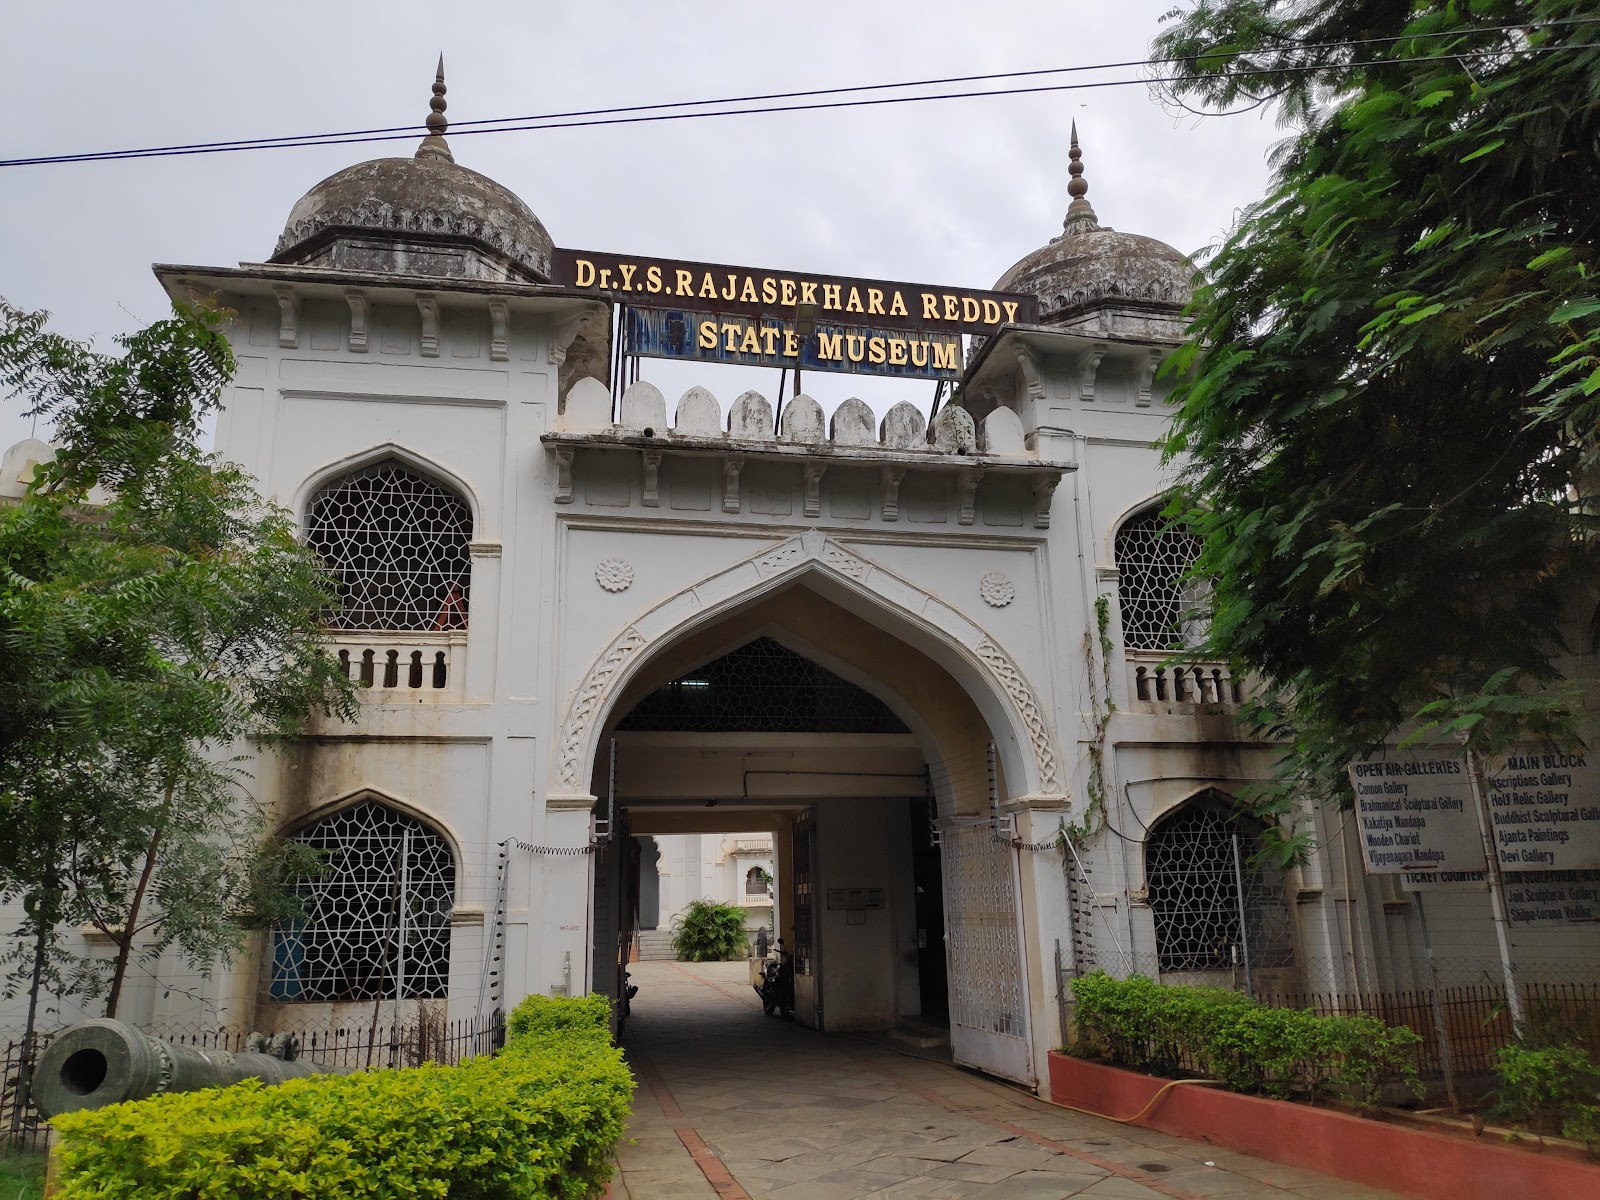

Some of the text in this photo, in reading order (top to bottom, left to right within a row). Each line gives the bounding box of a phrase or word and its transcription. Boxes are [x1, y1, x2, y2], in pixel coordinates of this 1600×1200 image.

[922, 293, 1019, 325] REDDY
[699, 320, 958, 370] STATE MUSEUM
[1356, 763, 1383, 777] OPEN
[1404, 761, 1460, 775] GALLERIES
[1508, 756, 1540, 770] MAIN
[1540, 772, 1571, 787] Gallery
[1358, 781, 1408, 796] Cannon Gallery
[1360, 796, 1463, 813] Brahmanical Sculptural Gallery
[1513, 792, 1534, 806] Relic
[1537, 791, 1568, 806] Gallery
[1363, 815, 1426, 831] Kakatiya Mandapa
[1494, 811, 1532, 825] Buddhist
[1533, 808, 1579, 825] Sculptural
[1366, 832, 1421, 847] Wooden Chariot
[1499, 828, 1569, 846] Ajanta Paintings
[1368, 848, 1445, 866] Vijayanagara Mandapa
[1501, 848, 1554, 865] Devi Gallery
[1406, 871, 1485, 884] TICKET COUNTER
[1508, 887, 1598, 904] Jain Sculptural Gallery
